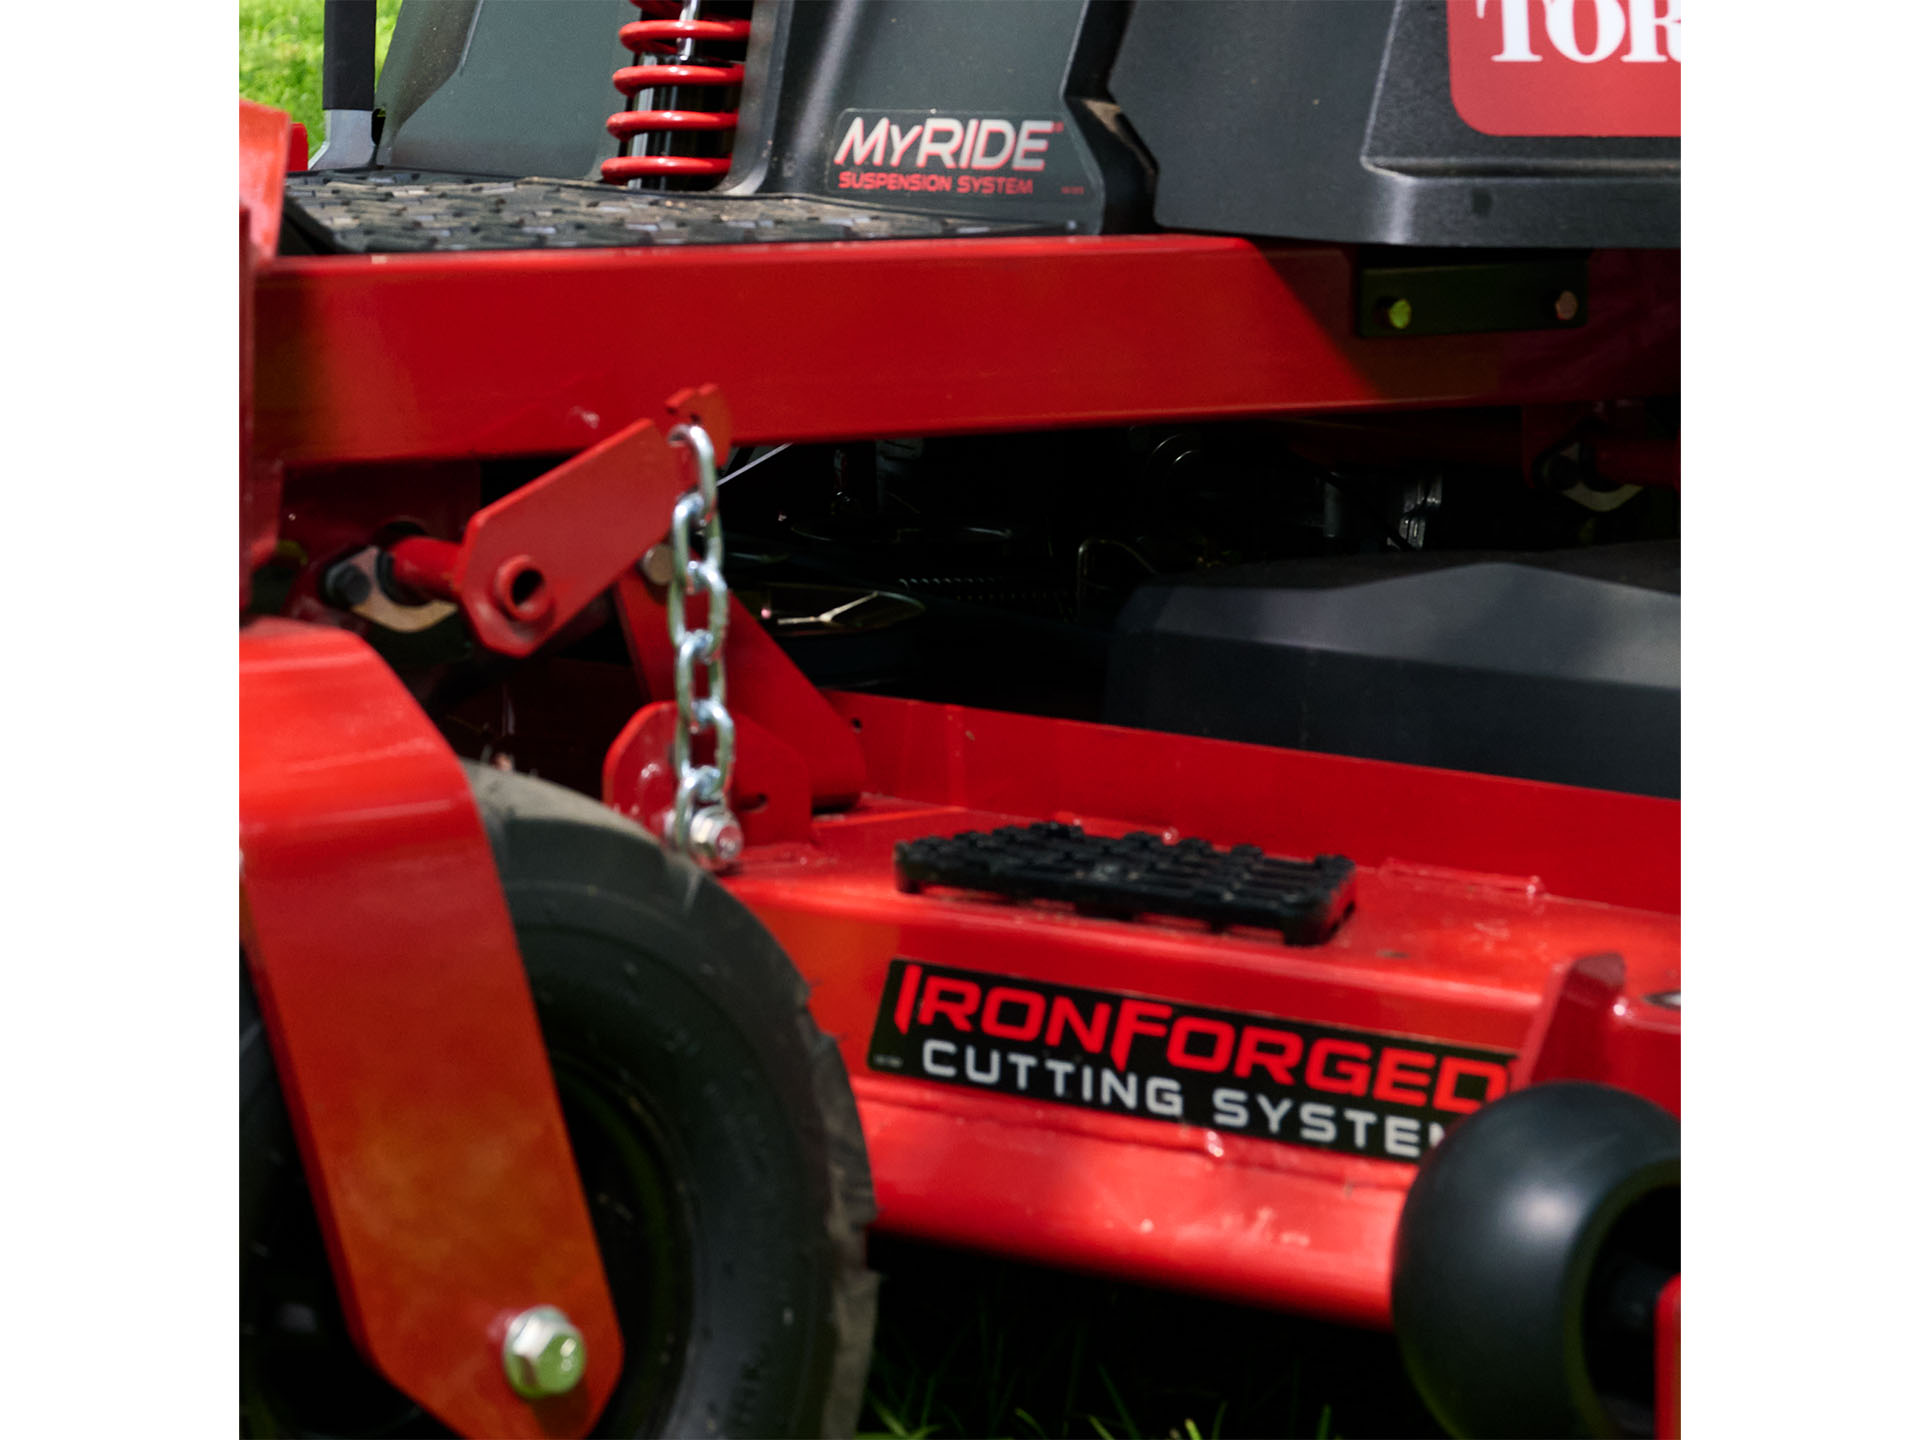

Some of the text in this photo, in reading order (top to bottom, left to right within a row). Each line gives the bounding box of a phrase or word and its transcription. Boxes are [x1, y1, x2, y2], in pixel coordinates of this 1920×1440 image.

[838, 171, 1033, 195] SUSPENSION SYSTEM
[894, 964, 1508, 1115] IRONFORGED
[922, 1039, 1445, 1158] CUTTING SYSTE
